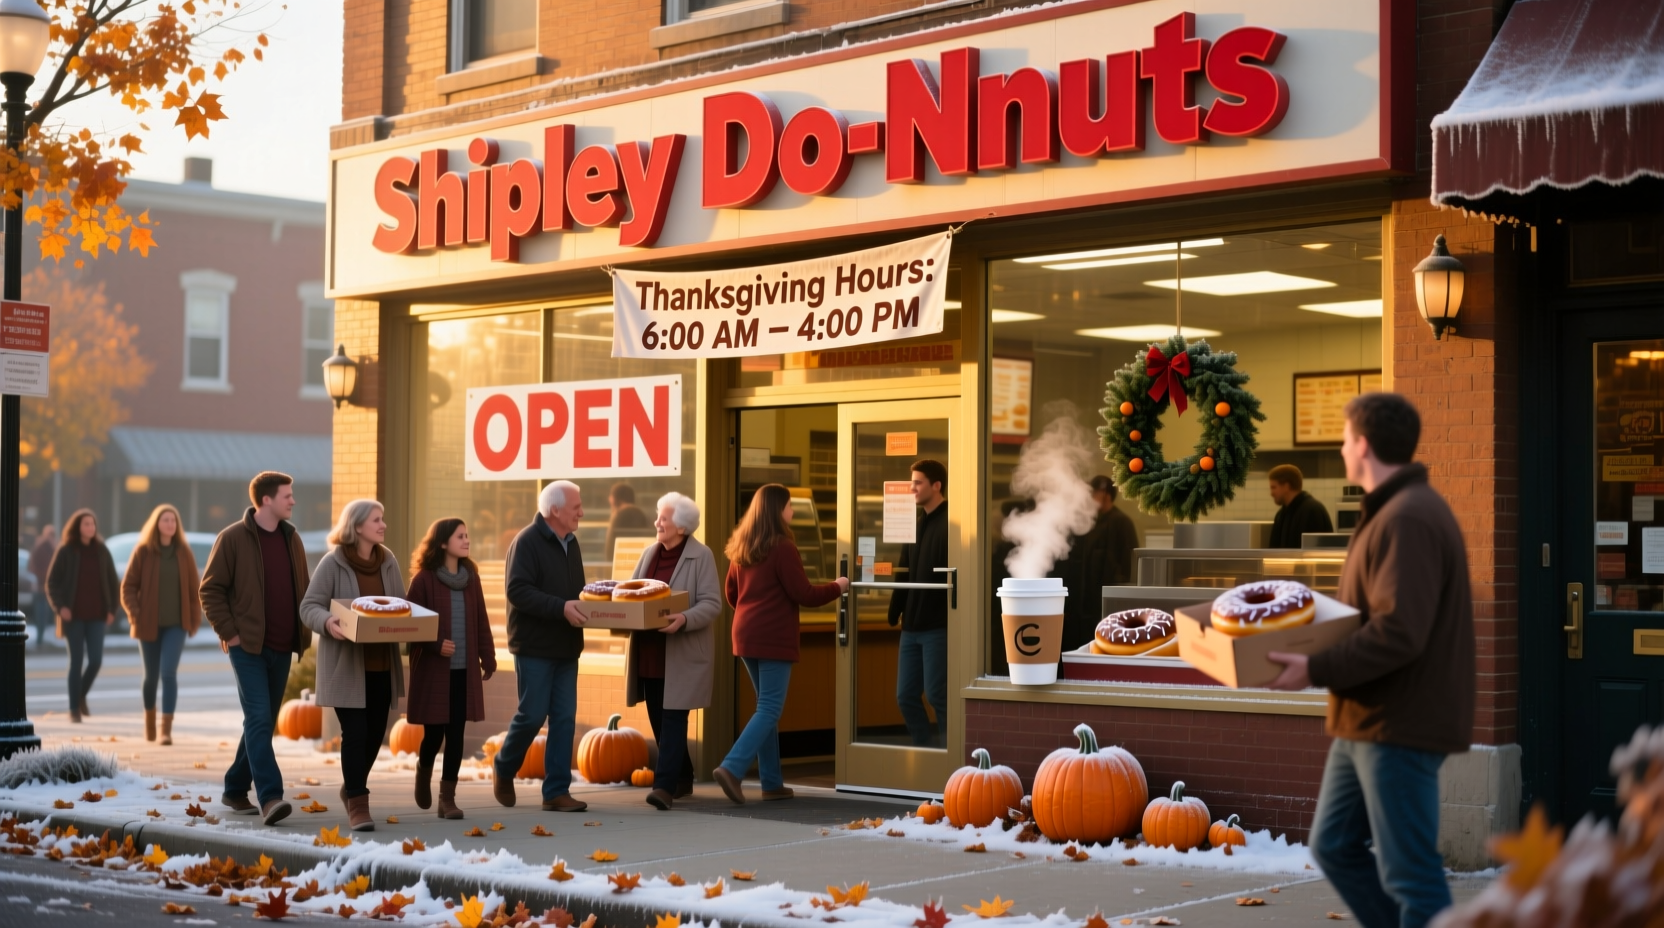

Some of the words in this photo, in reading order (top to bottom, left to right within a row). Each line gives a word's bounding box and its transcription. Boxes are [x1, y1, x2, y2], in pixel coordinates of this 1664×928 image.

[372, 124, 686, 262] Shipley
[702, 11, 1290, 209] Do-Nnuts
[636, 271, 825, 316] Thanksgiving
[835, 258, 935, 297] Hours:
[641, 320, 704, 350] 6:00
[712, 317, 760, 349] AM
[797, 305, 863, 342] 4:00
[871, 296, 920, 333] PM
[473, 385, 669, 472] OPEN
